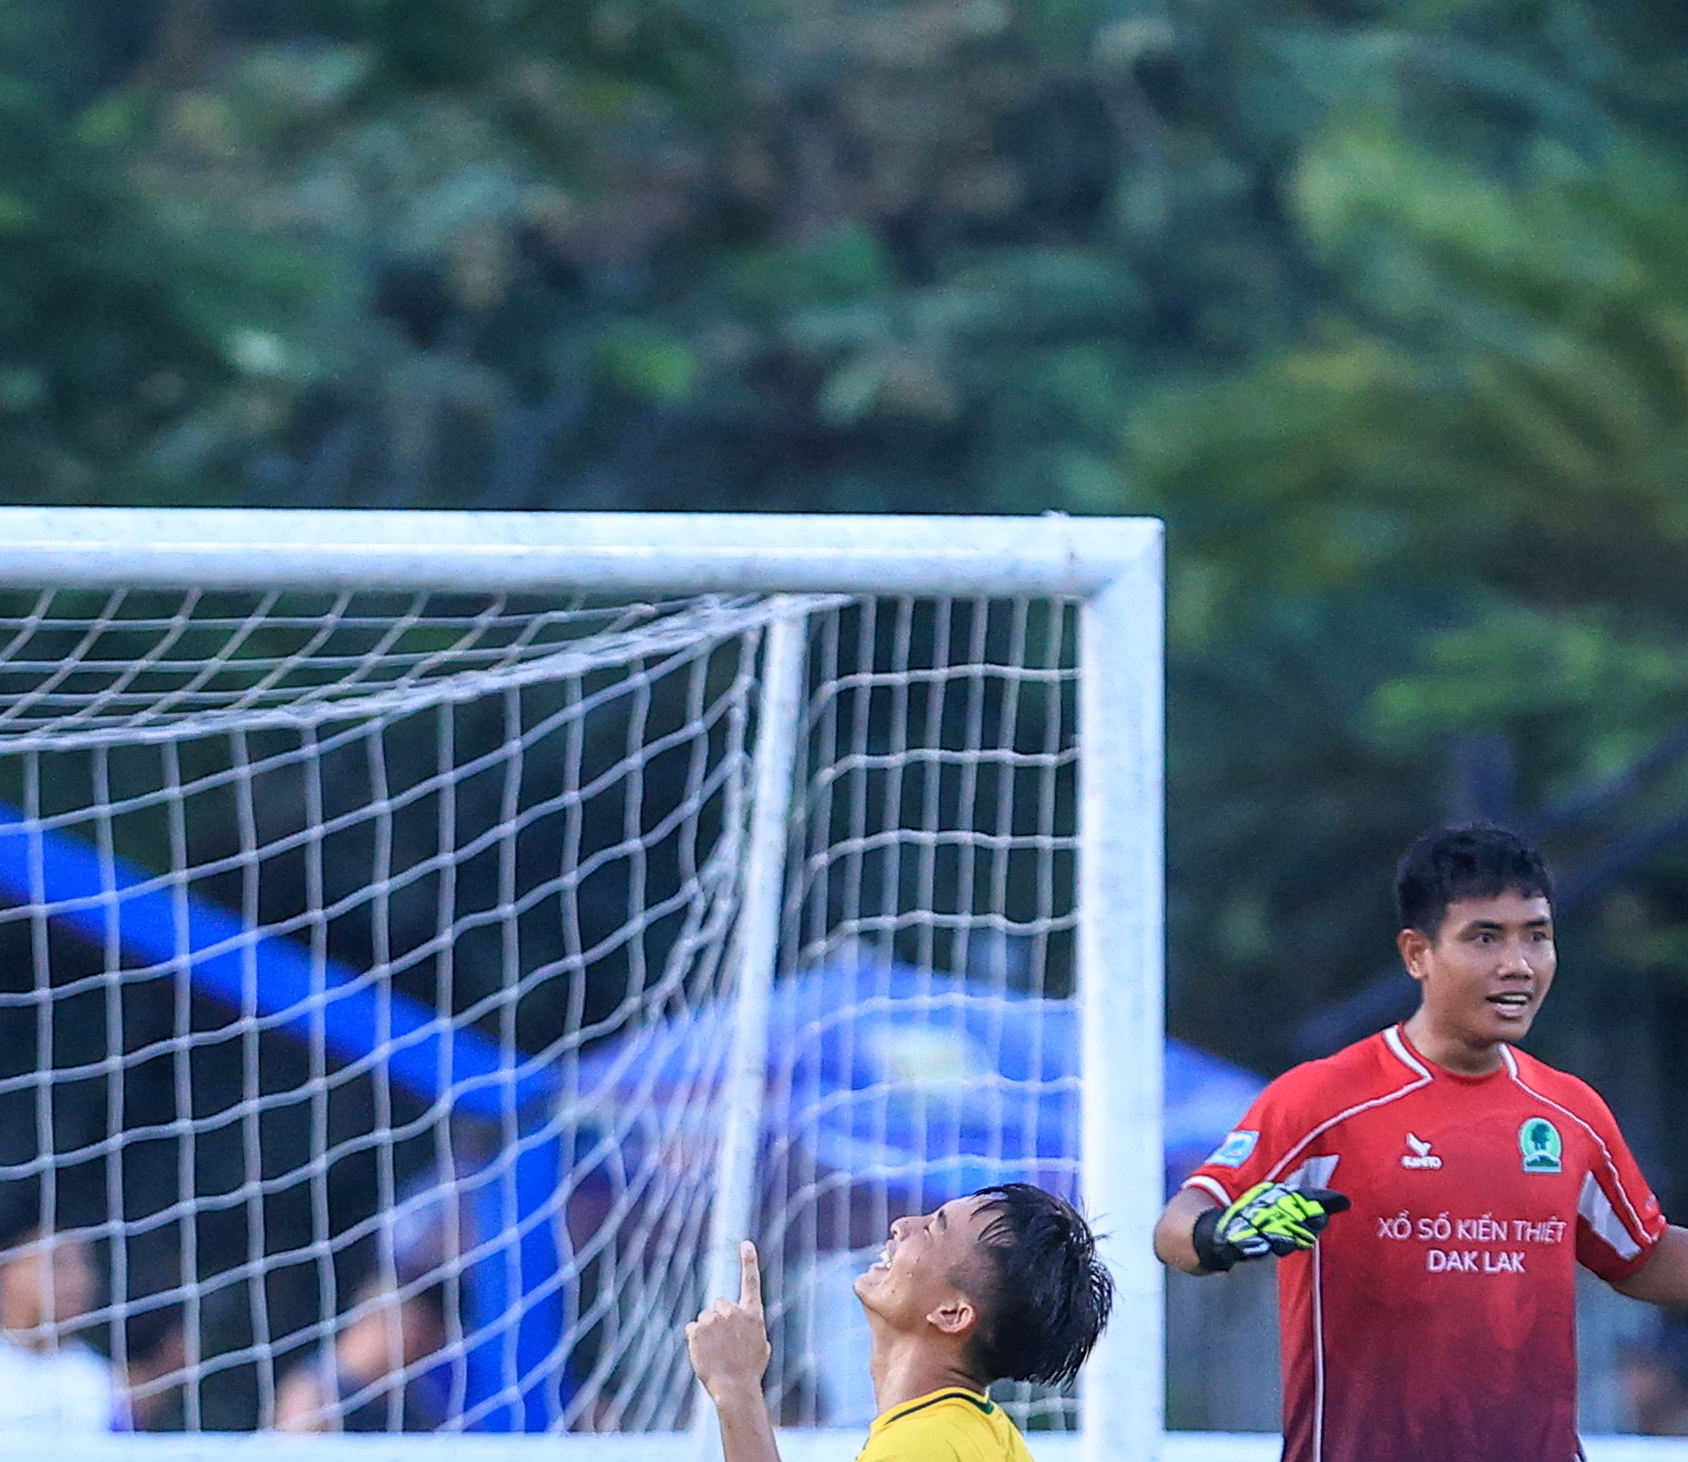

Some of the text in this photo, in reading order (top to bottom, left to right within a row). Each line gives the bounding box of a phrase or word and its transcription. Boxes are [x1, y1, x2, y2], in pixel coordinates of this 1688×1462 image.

[1377, 1209, 1412, 1240] XỔ
[1417, 1210, 1452, 1241] SỐ
[1457, 1211, 1508, 1242] KIẾN
[1426, 1249, 1526, 1274] DAK LAK
